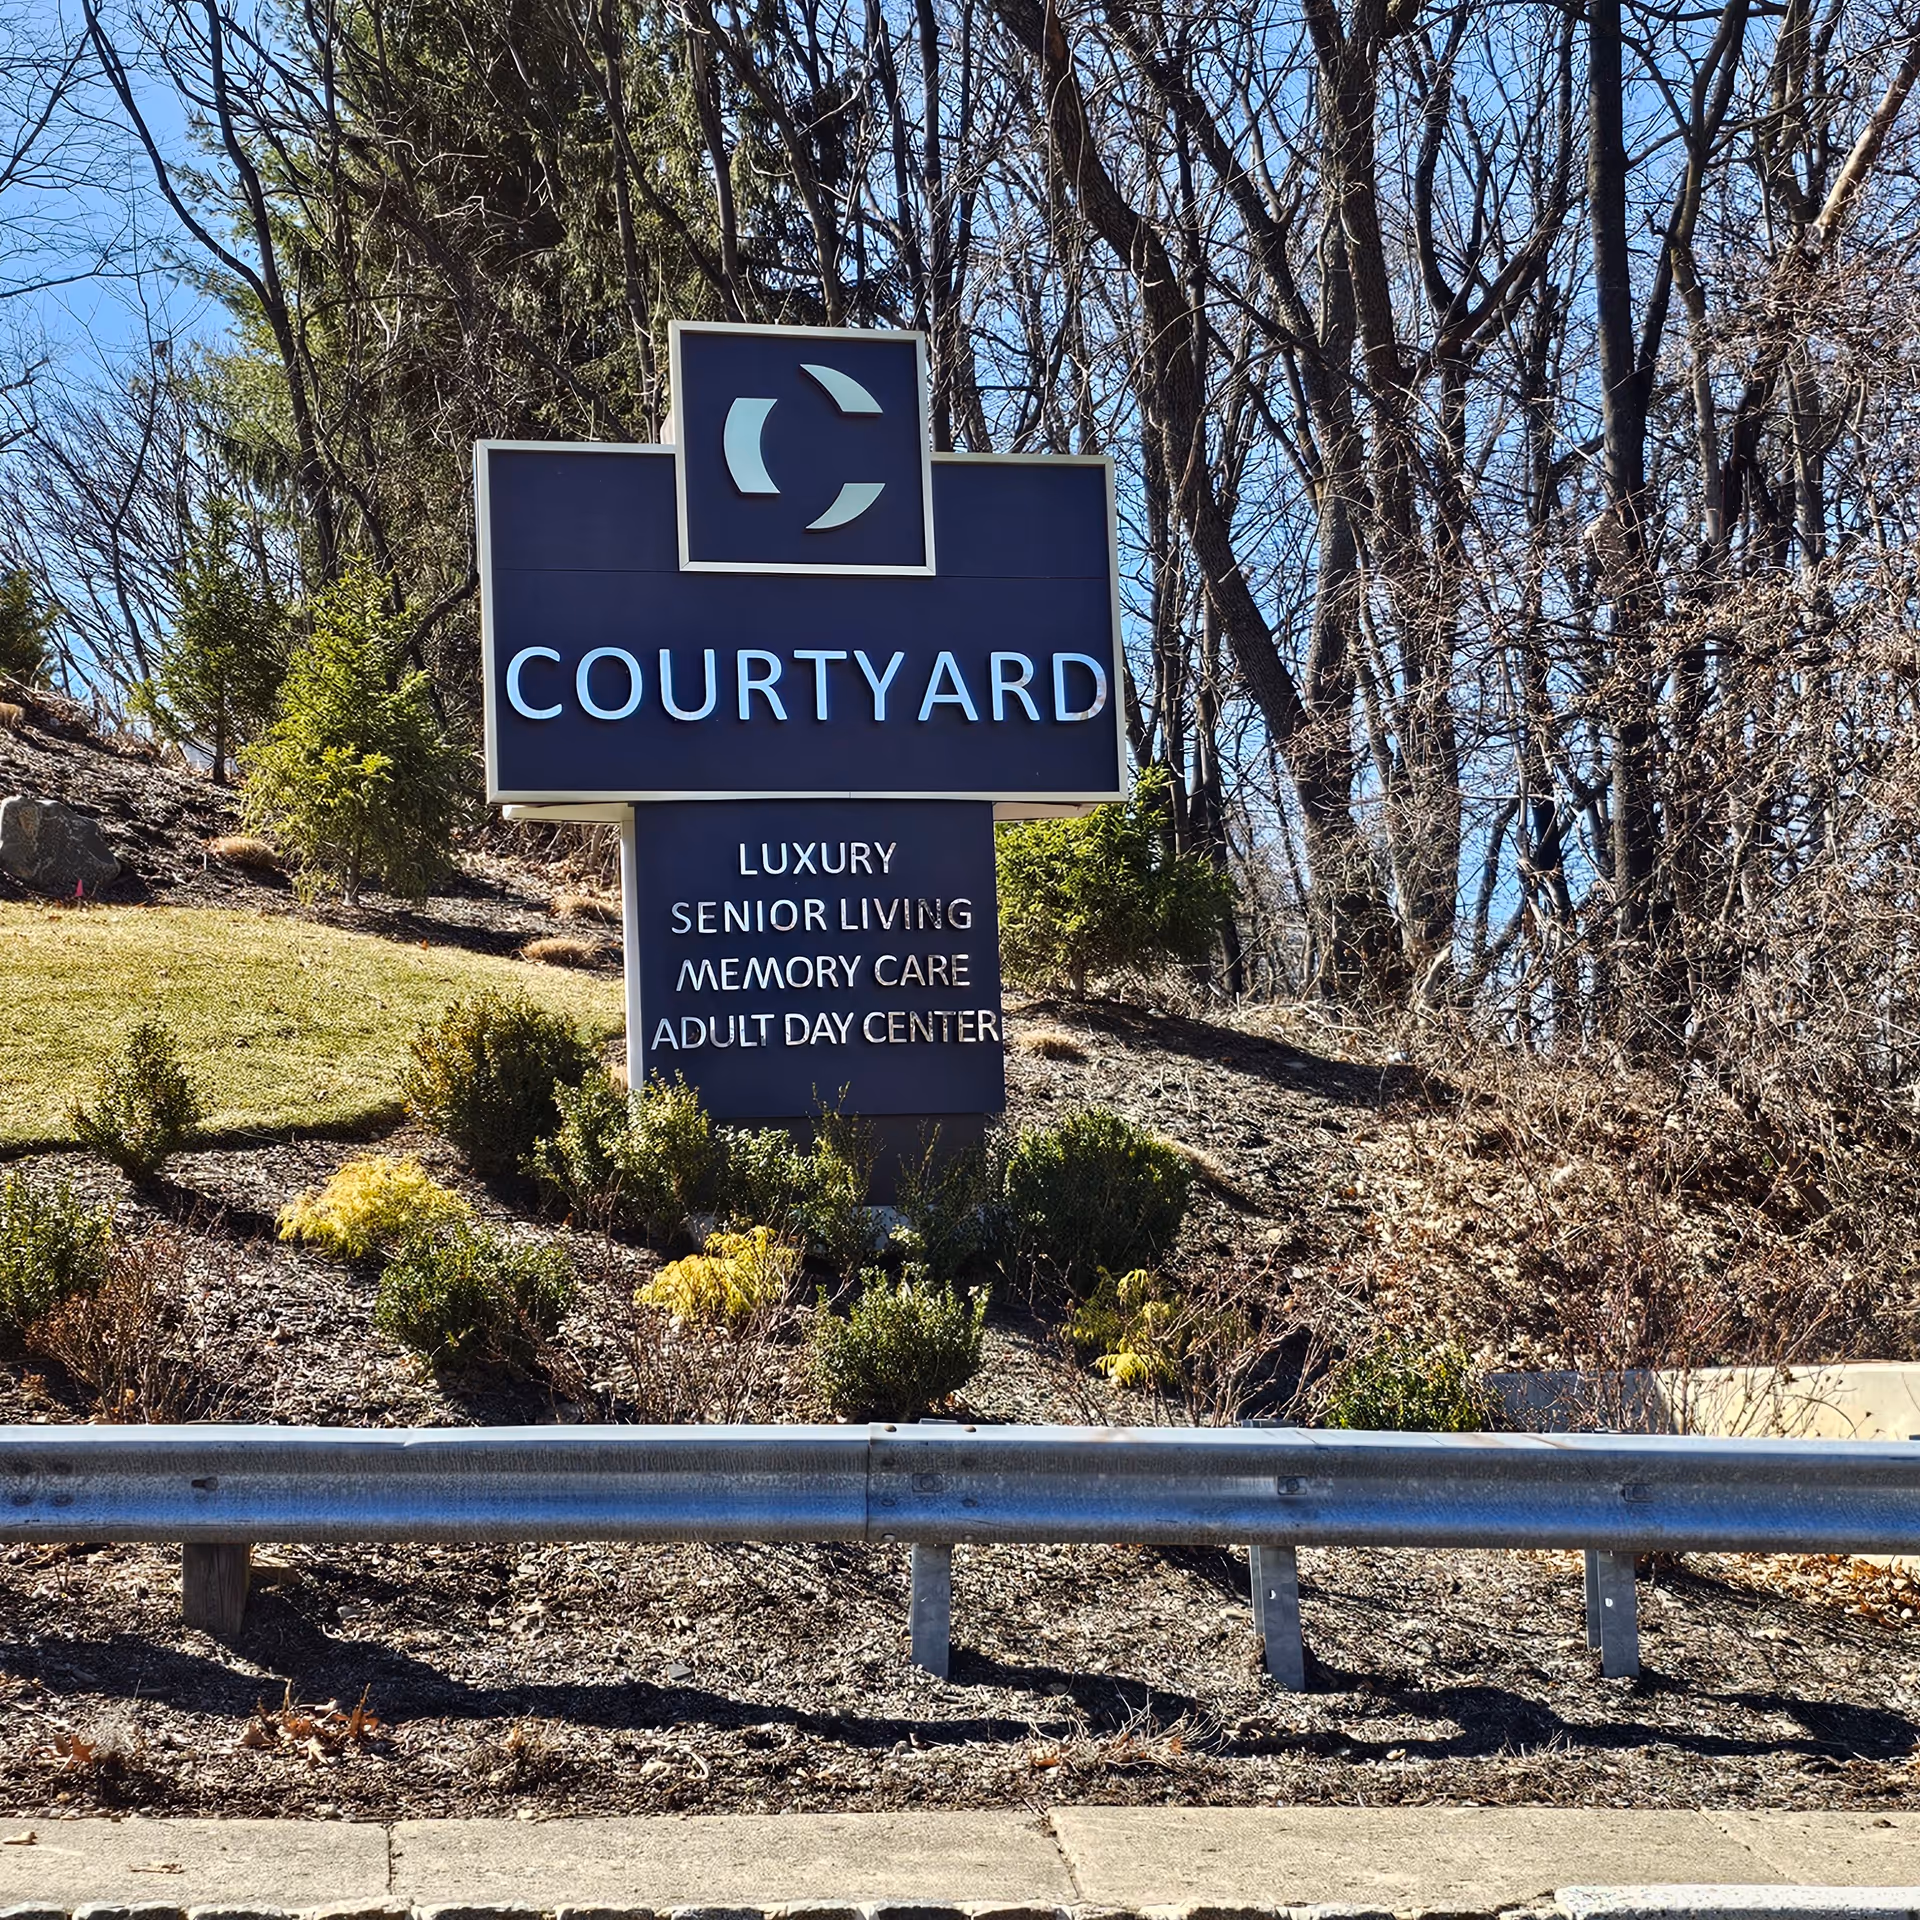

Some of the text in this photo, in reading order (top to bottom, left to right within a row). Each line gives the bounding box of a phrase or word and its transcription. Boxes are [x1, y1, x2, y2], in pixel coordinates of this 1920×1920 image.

[506, 646, 1107, 722] COURTYARD
[739, 841, 897, 876] LUXURY
[671, 897, 972, 934] SENIOR LIVING
[675, 953, 971, 992] MEMORY CARE
[650, 1009, 1001, 1051] ADULT DAY CENTER
